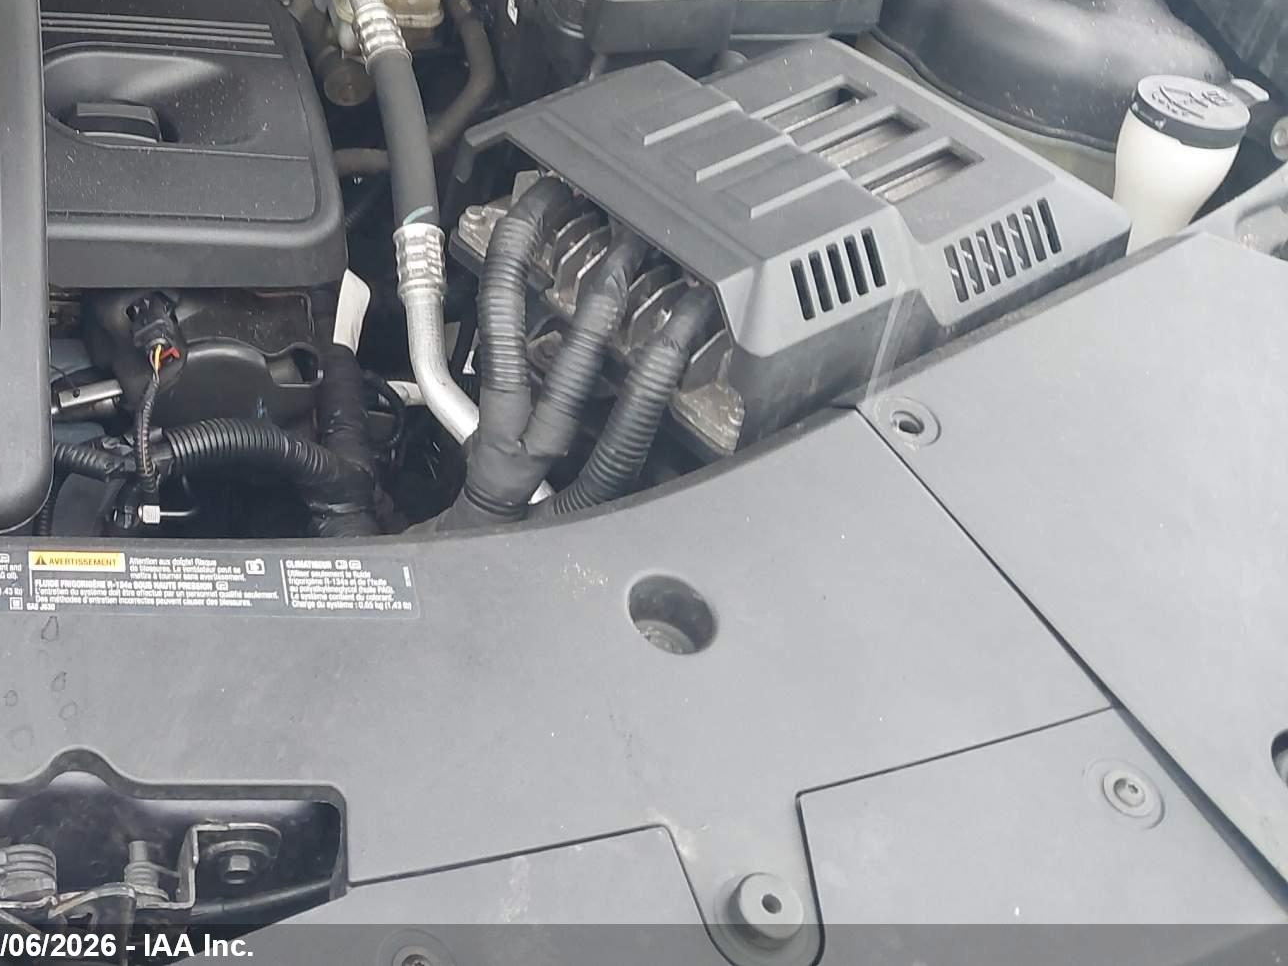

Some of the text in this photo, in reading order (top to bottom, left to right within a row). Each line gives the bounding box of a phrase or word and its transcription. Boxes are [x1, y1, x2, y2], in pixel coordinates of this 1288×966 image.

[49, 557, 116, 566] AVERTISSEMENT
[35, 579, 59, 588] FLUIDE
[153, 581, 176, 590] HAUTE
[178, 581, 212, 590] PRESSION
